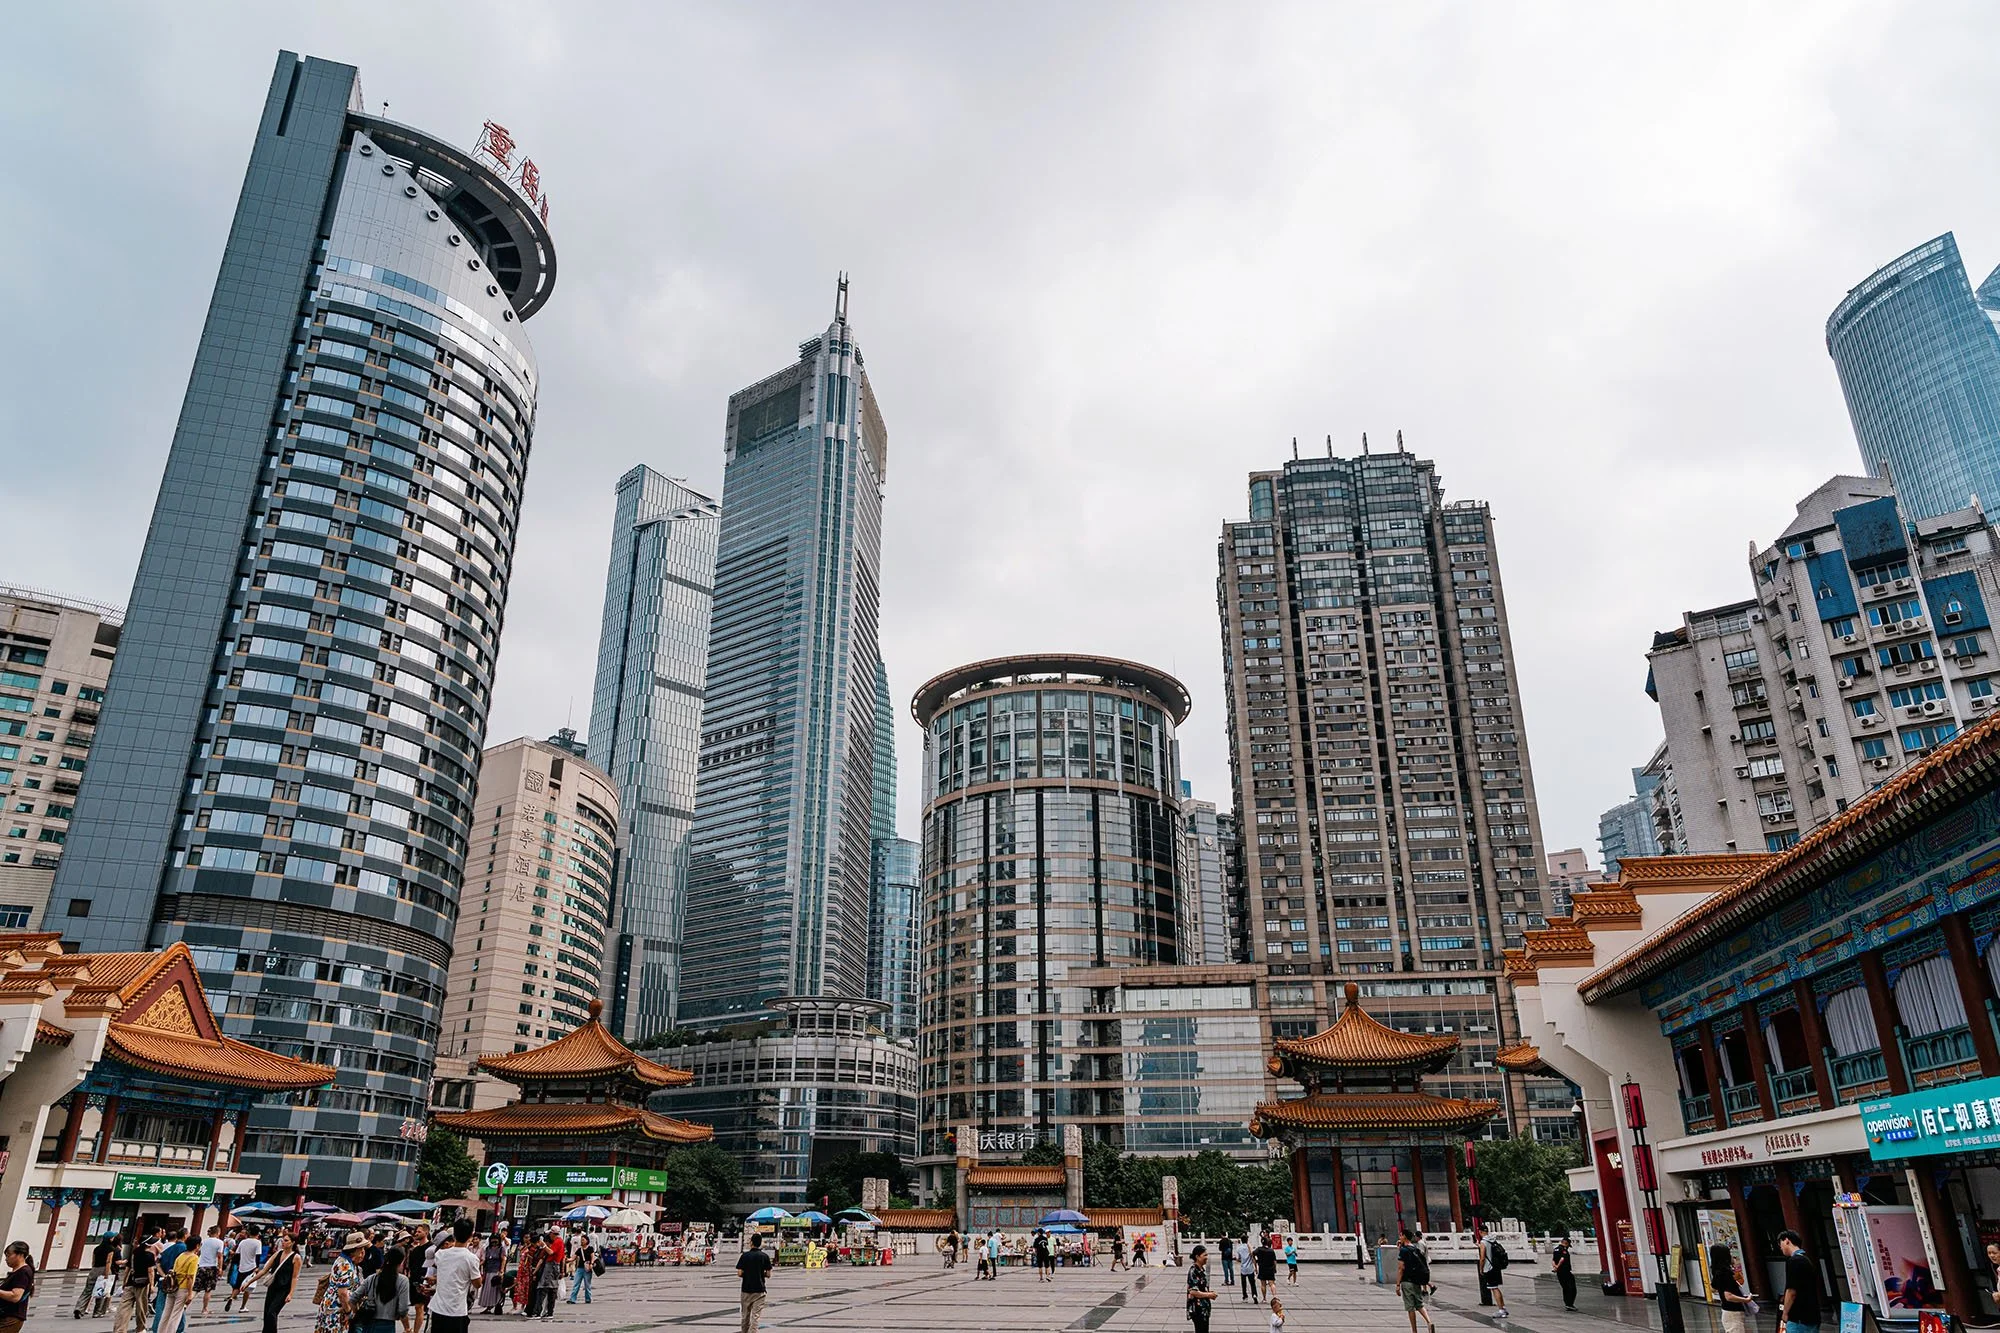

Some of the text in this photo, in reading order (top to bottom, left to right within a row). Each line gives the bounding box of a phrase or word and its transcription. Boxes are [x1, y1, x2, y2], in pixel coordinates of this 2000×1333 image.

[508, 803, 539, 903] 君亭酒店
[1867, 1112, 1911, 1135] openvision
[122, 1181, 208, 1196] 和平新健康药房
